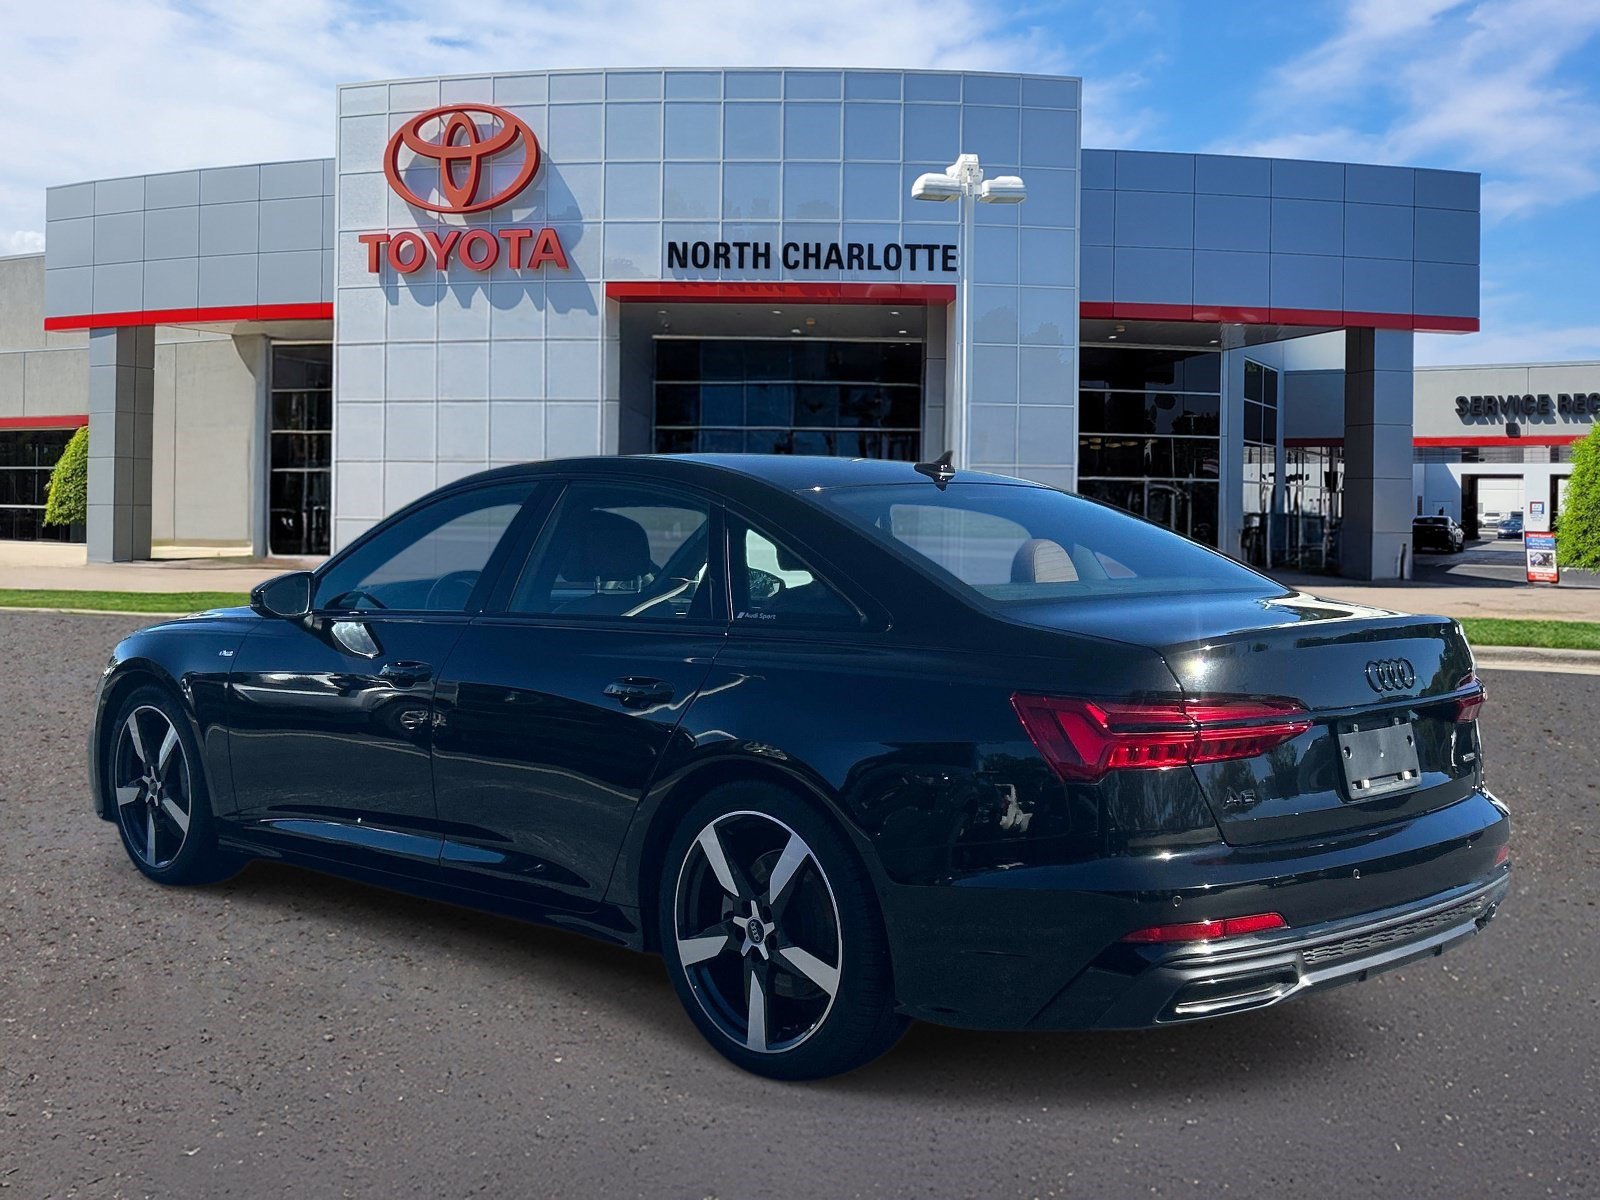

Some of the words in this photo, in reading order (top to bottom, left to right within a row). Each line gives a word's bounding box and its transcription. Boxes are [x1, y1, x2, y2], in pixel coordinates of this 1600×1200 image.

[358, 228, 569, 274] TOYOTA
[667, 241, 771, 270] NORTH
[781, 241, 958, 272] CHARLOTTE
[1455, 394, 1552, 417] SERVICE
